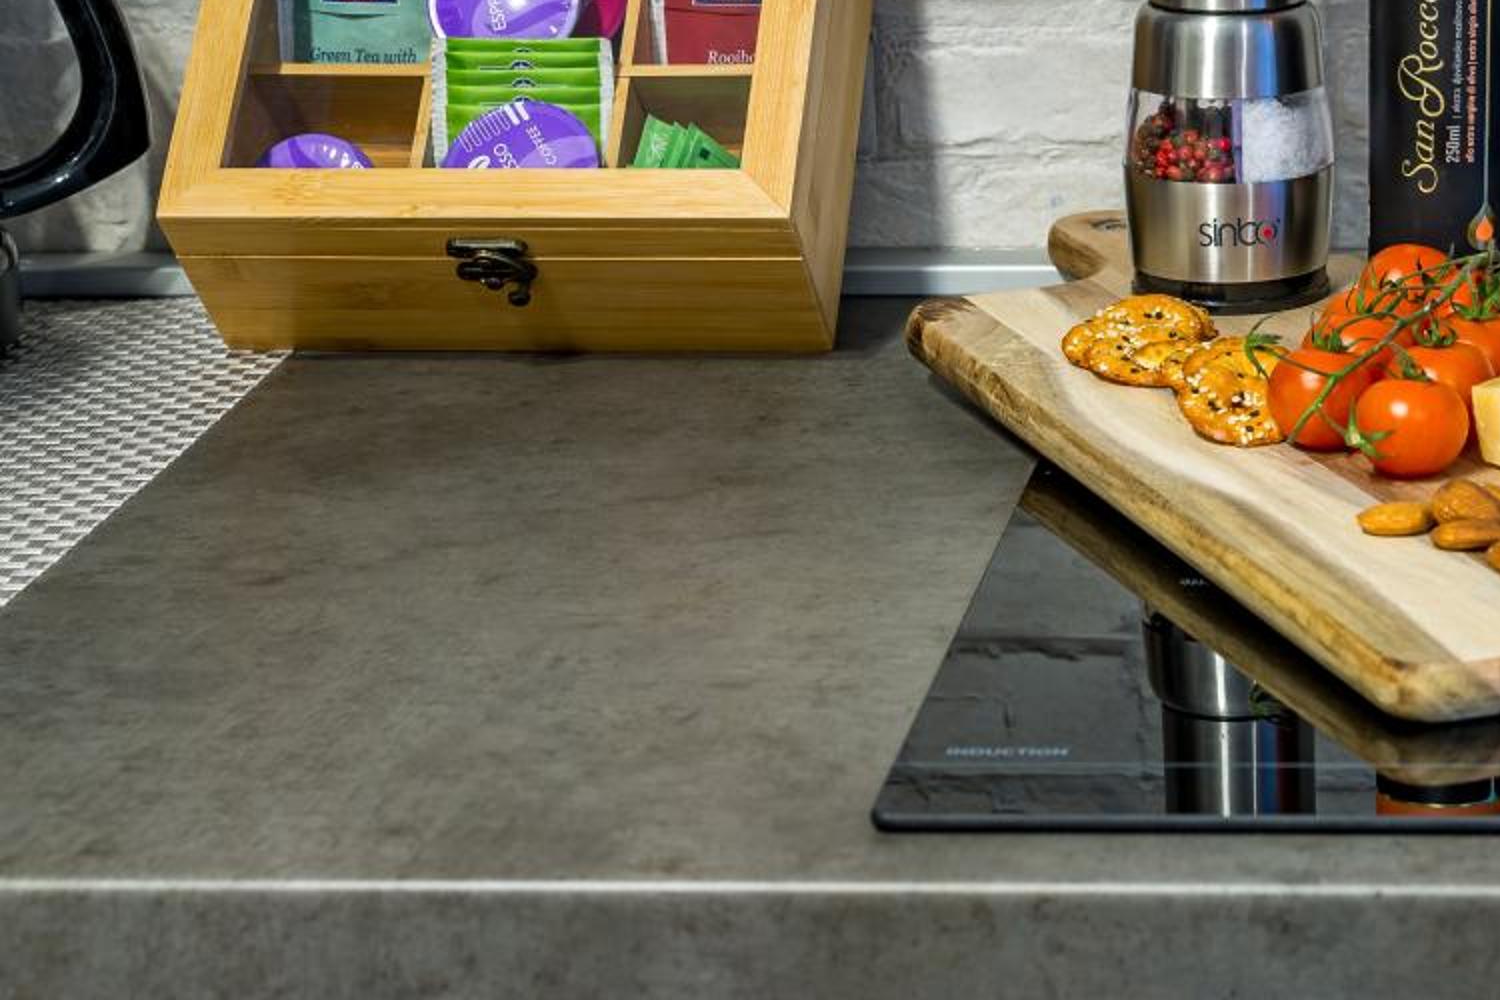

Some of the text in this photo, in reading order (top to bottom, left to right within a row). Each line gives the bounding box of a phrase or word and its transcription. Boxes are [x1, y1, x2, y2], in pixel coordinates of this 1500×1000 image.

[311, 47, 417, 64] Green Tea with
[1401, 120, 1439, 193] San
[1445, 125, 1461, 164] 250ml
[1198, 217, 1279, 248] sinbo
[945, 745, 1070, 757] INDUCTION
